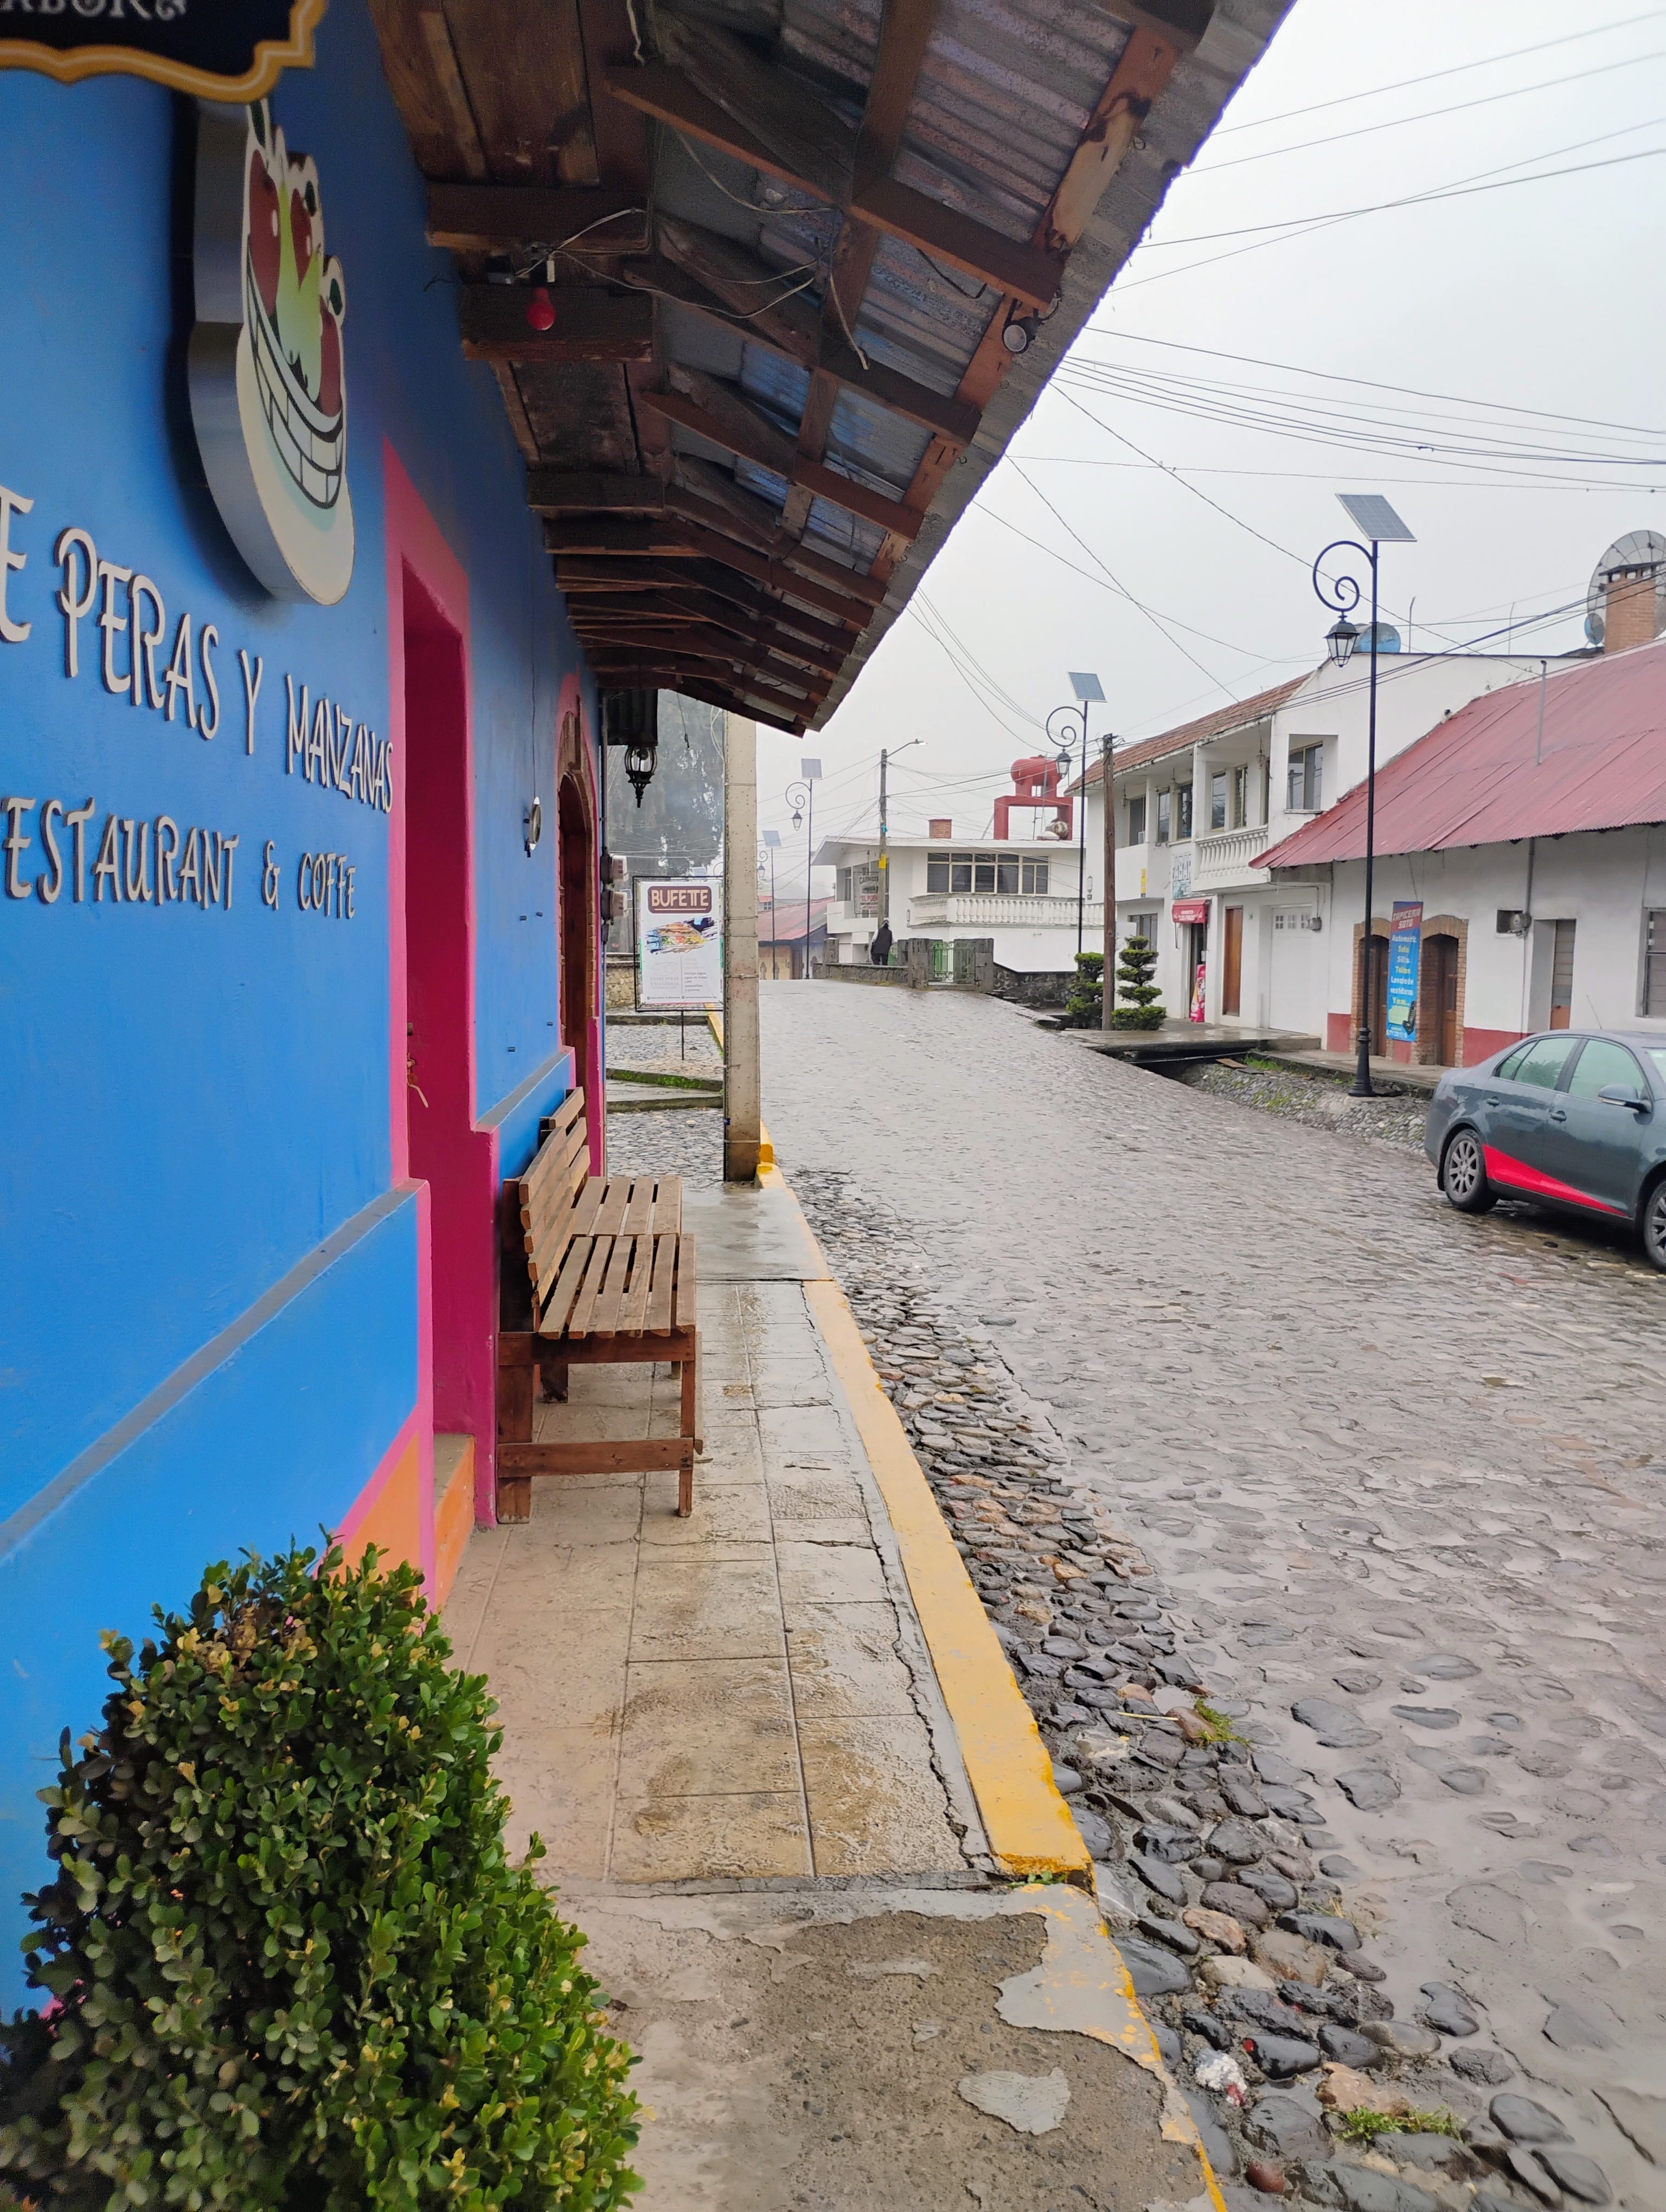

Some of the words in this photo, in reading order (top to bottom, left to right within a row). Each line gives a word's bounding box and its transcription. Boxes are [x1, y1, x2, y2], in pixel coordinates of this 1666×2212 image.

[54, 527, 219, 740] PERAS
[239, 650, 263, 755] Y
[286, 673, 393, 814] MANZANAS
[2, 796, 239, 910] ESTAURANT
[262, 840, 280, 910] &
[297, 852, 356, 919] COFFE
[651, 889, 709, 907] BUFETTE
